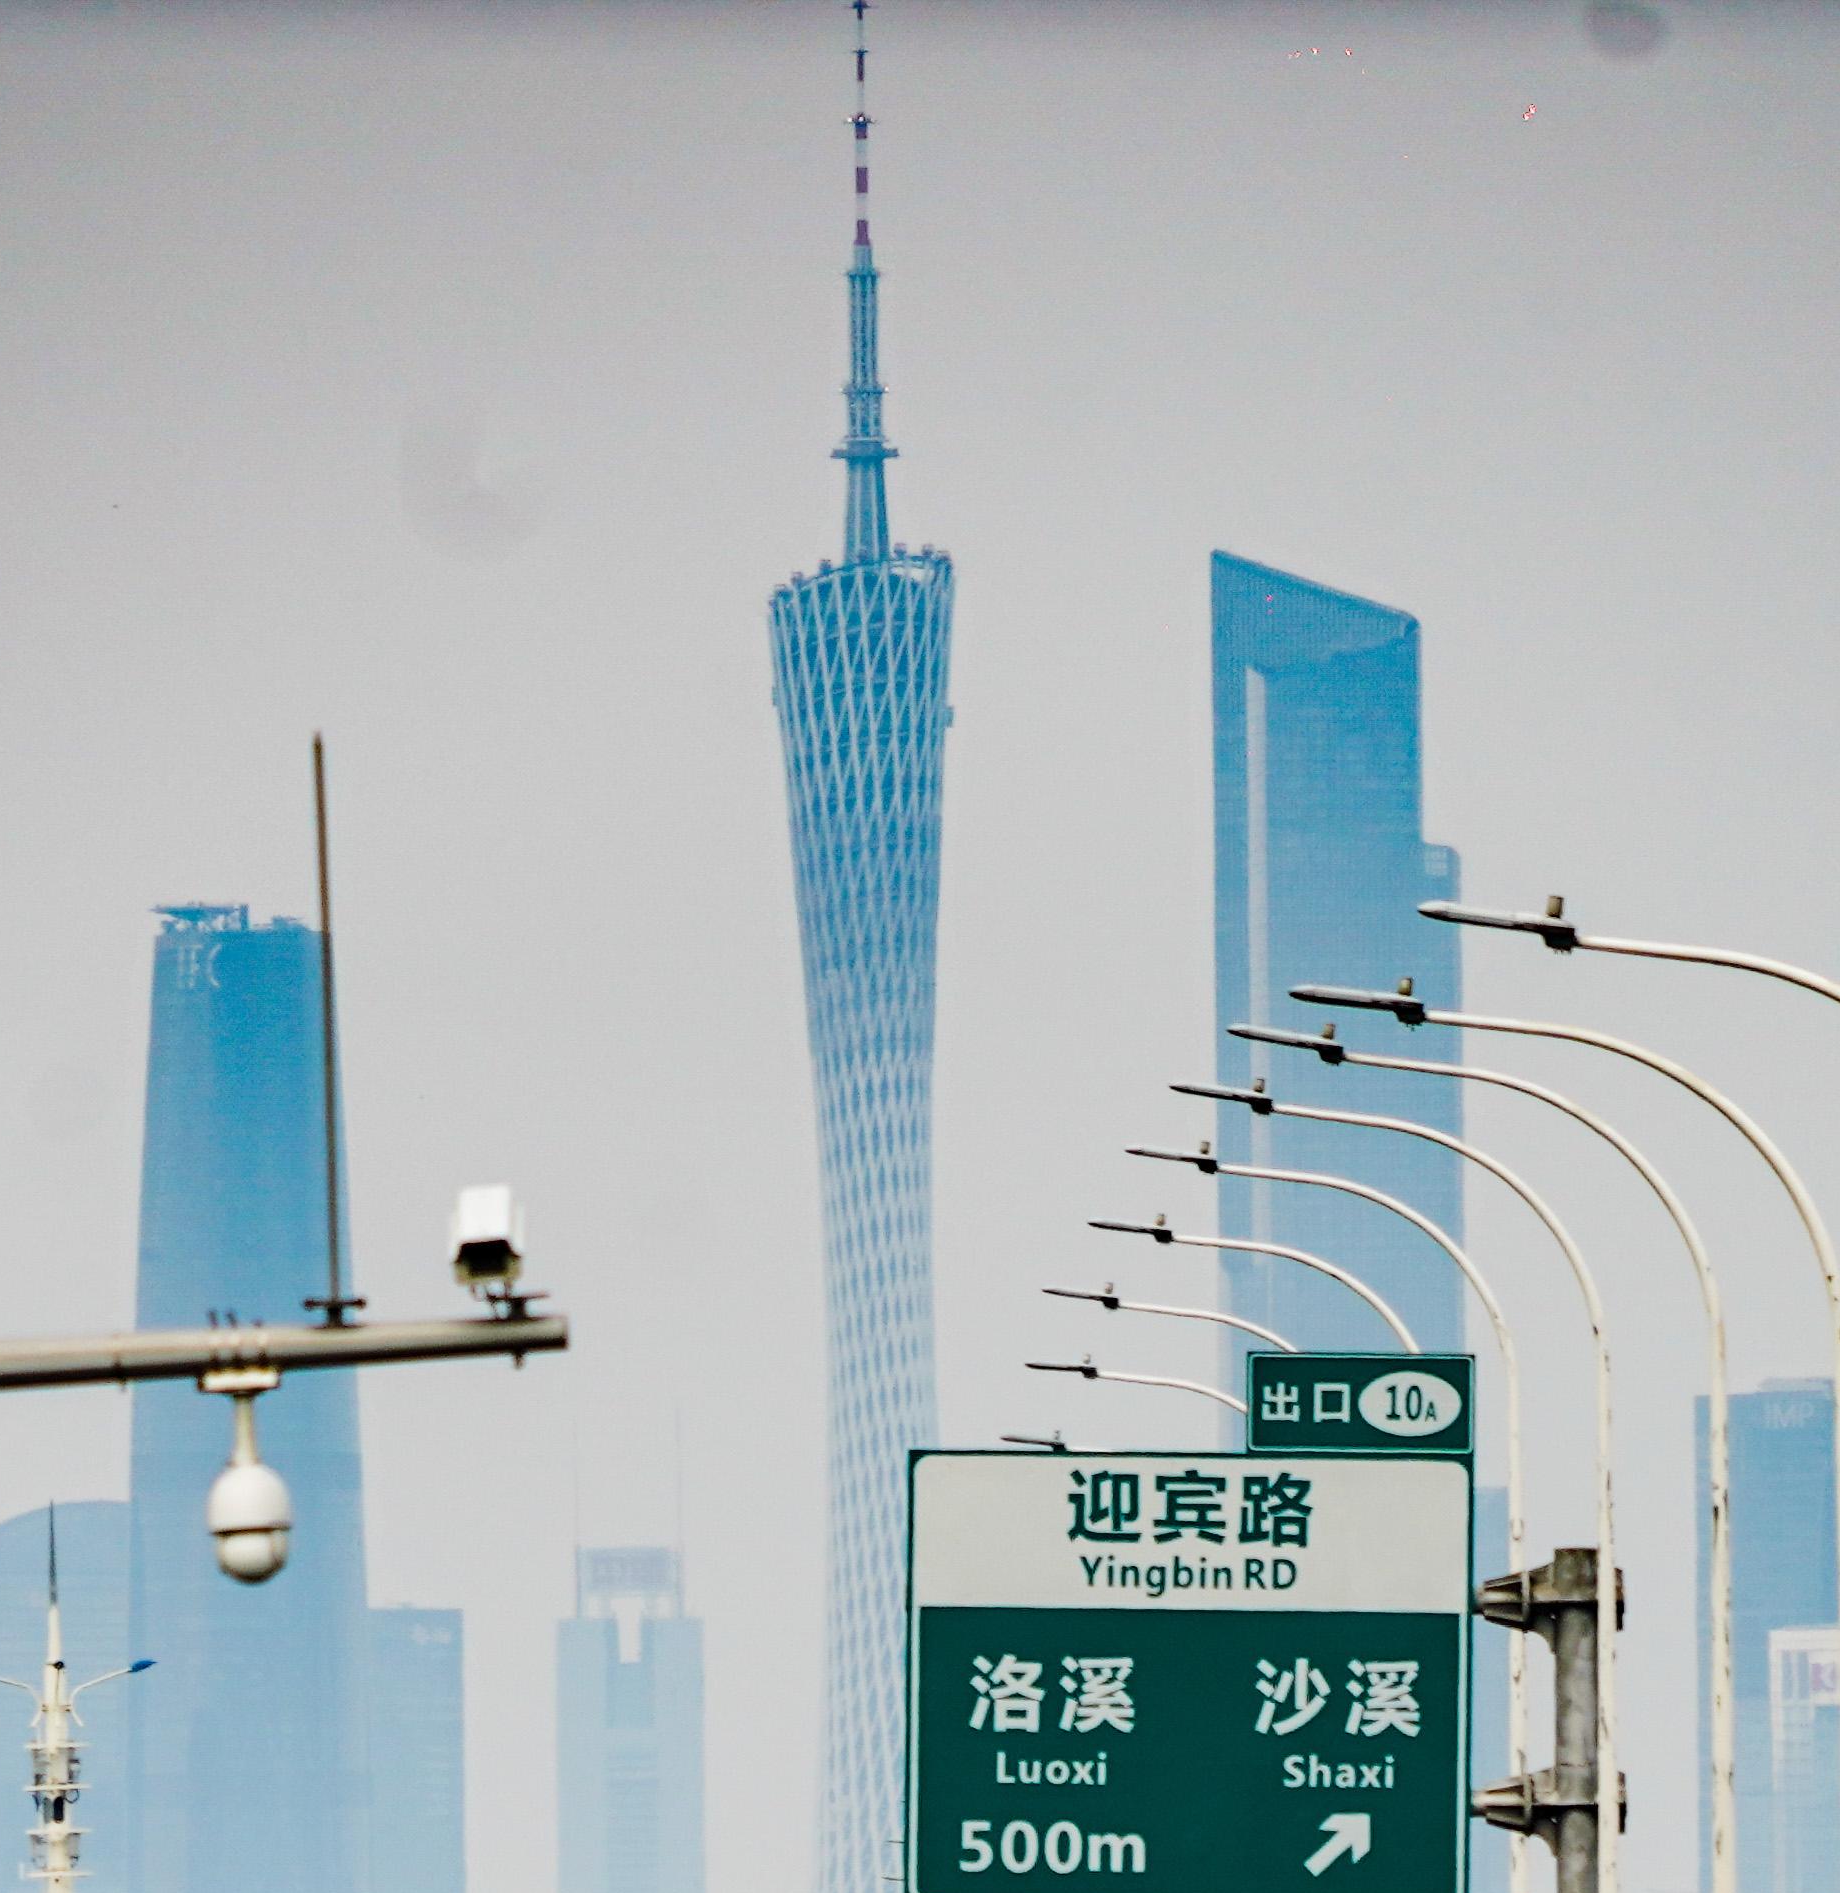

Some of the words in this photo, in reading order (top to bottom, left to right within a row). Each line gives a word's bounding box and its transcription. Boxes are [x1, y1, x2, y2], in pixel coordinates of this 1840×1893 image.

[1261, 1382, 1351, 1424] 出口
[1385, 1384, 1437, 1421] 10A
[1067, 1469, 1314, 1549] 迎宾路
[1080, 1555, 1232, 1598] Yingbin
[1245, 1558, 1298, 1590] RD
[969, 1654, 1135, 1733] 洛溪
[1254, 1657, 1421, 1738] 沙溪
[996, 1751, 1108, 1787] Luoxi
[1282, 1753, 1396, 1790] Shaxi
[958, 1819, 1147, 1875] 500m
